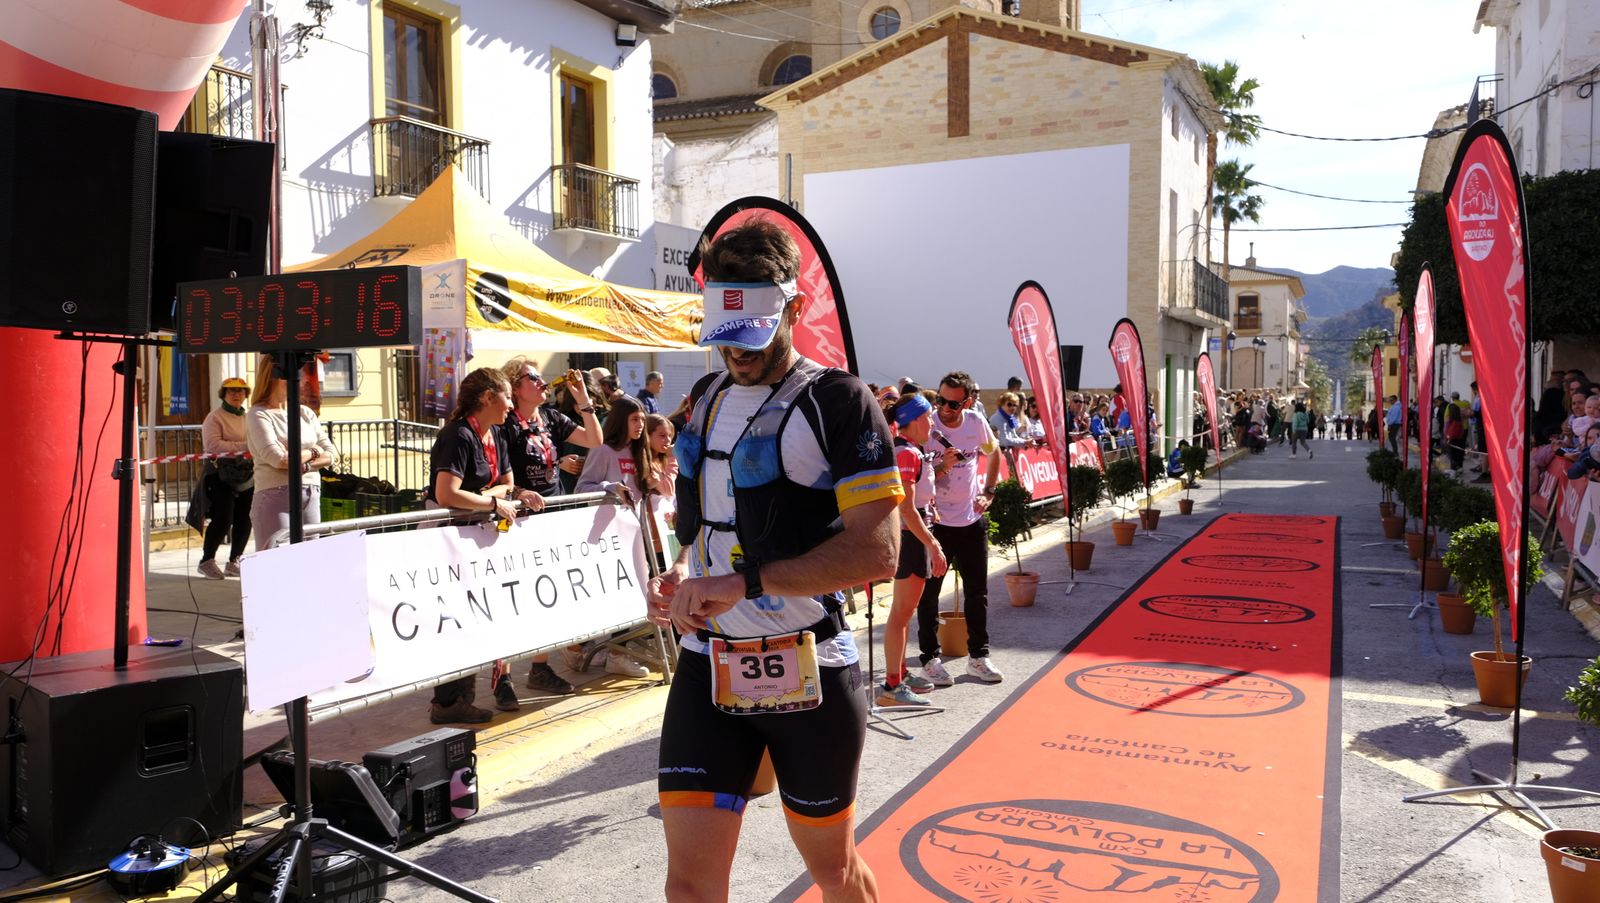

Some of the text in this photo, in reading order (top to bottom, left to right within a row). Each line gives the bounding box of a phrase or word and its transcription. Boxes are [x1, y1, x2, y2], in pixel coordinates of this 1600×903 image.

[663, 247, 692, 267] EXCE
[1030, 461, 1058, 484] VEOLI
[389, 535, 621, 591] AYUNTAMIENTO DE
[391, 558, 633, 641] CANTORIA
[1133, 636, 1281, 652] Ayuntamiento
[1148, 632, 1238, 643] Cantoria
[740, 655, 784, 679] 36
[1040, 741, 1251, 773] Ayuntamiento
[1066, 734, 1235, 759] de Cantoria
[1000, 807, 1095, 826] Cantoria
[1098, 842, 1148, 856] Cxm
[1179, 841, 1232, 860] LA
